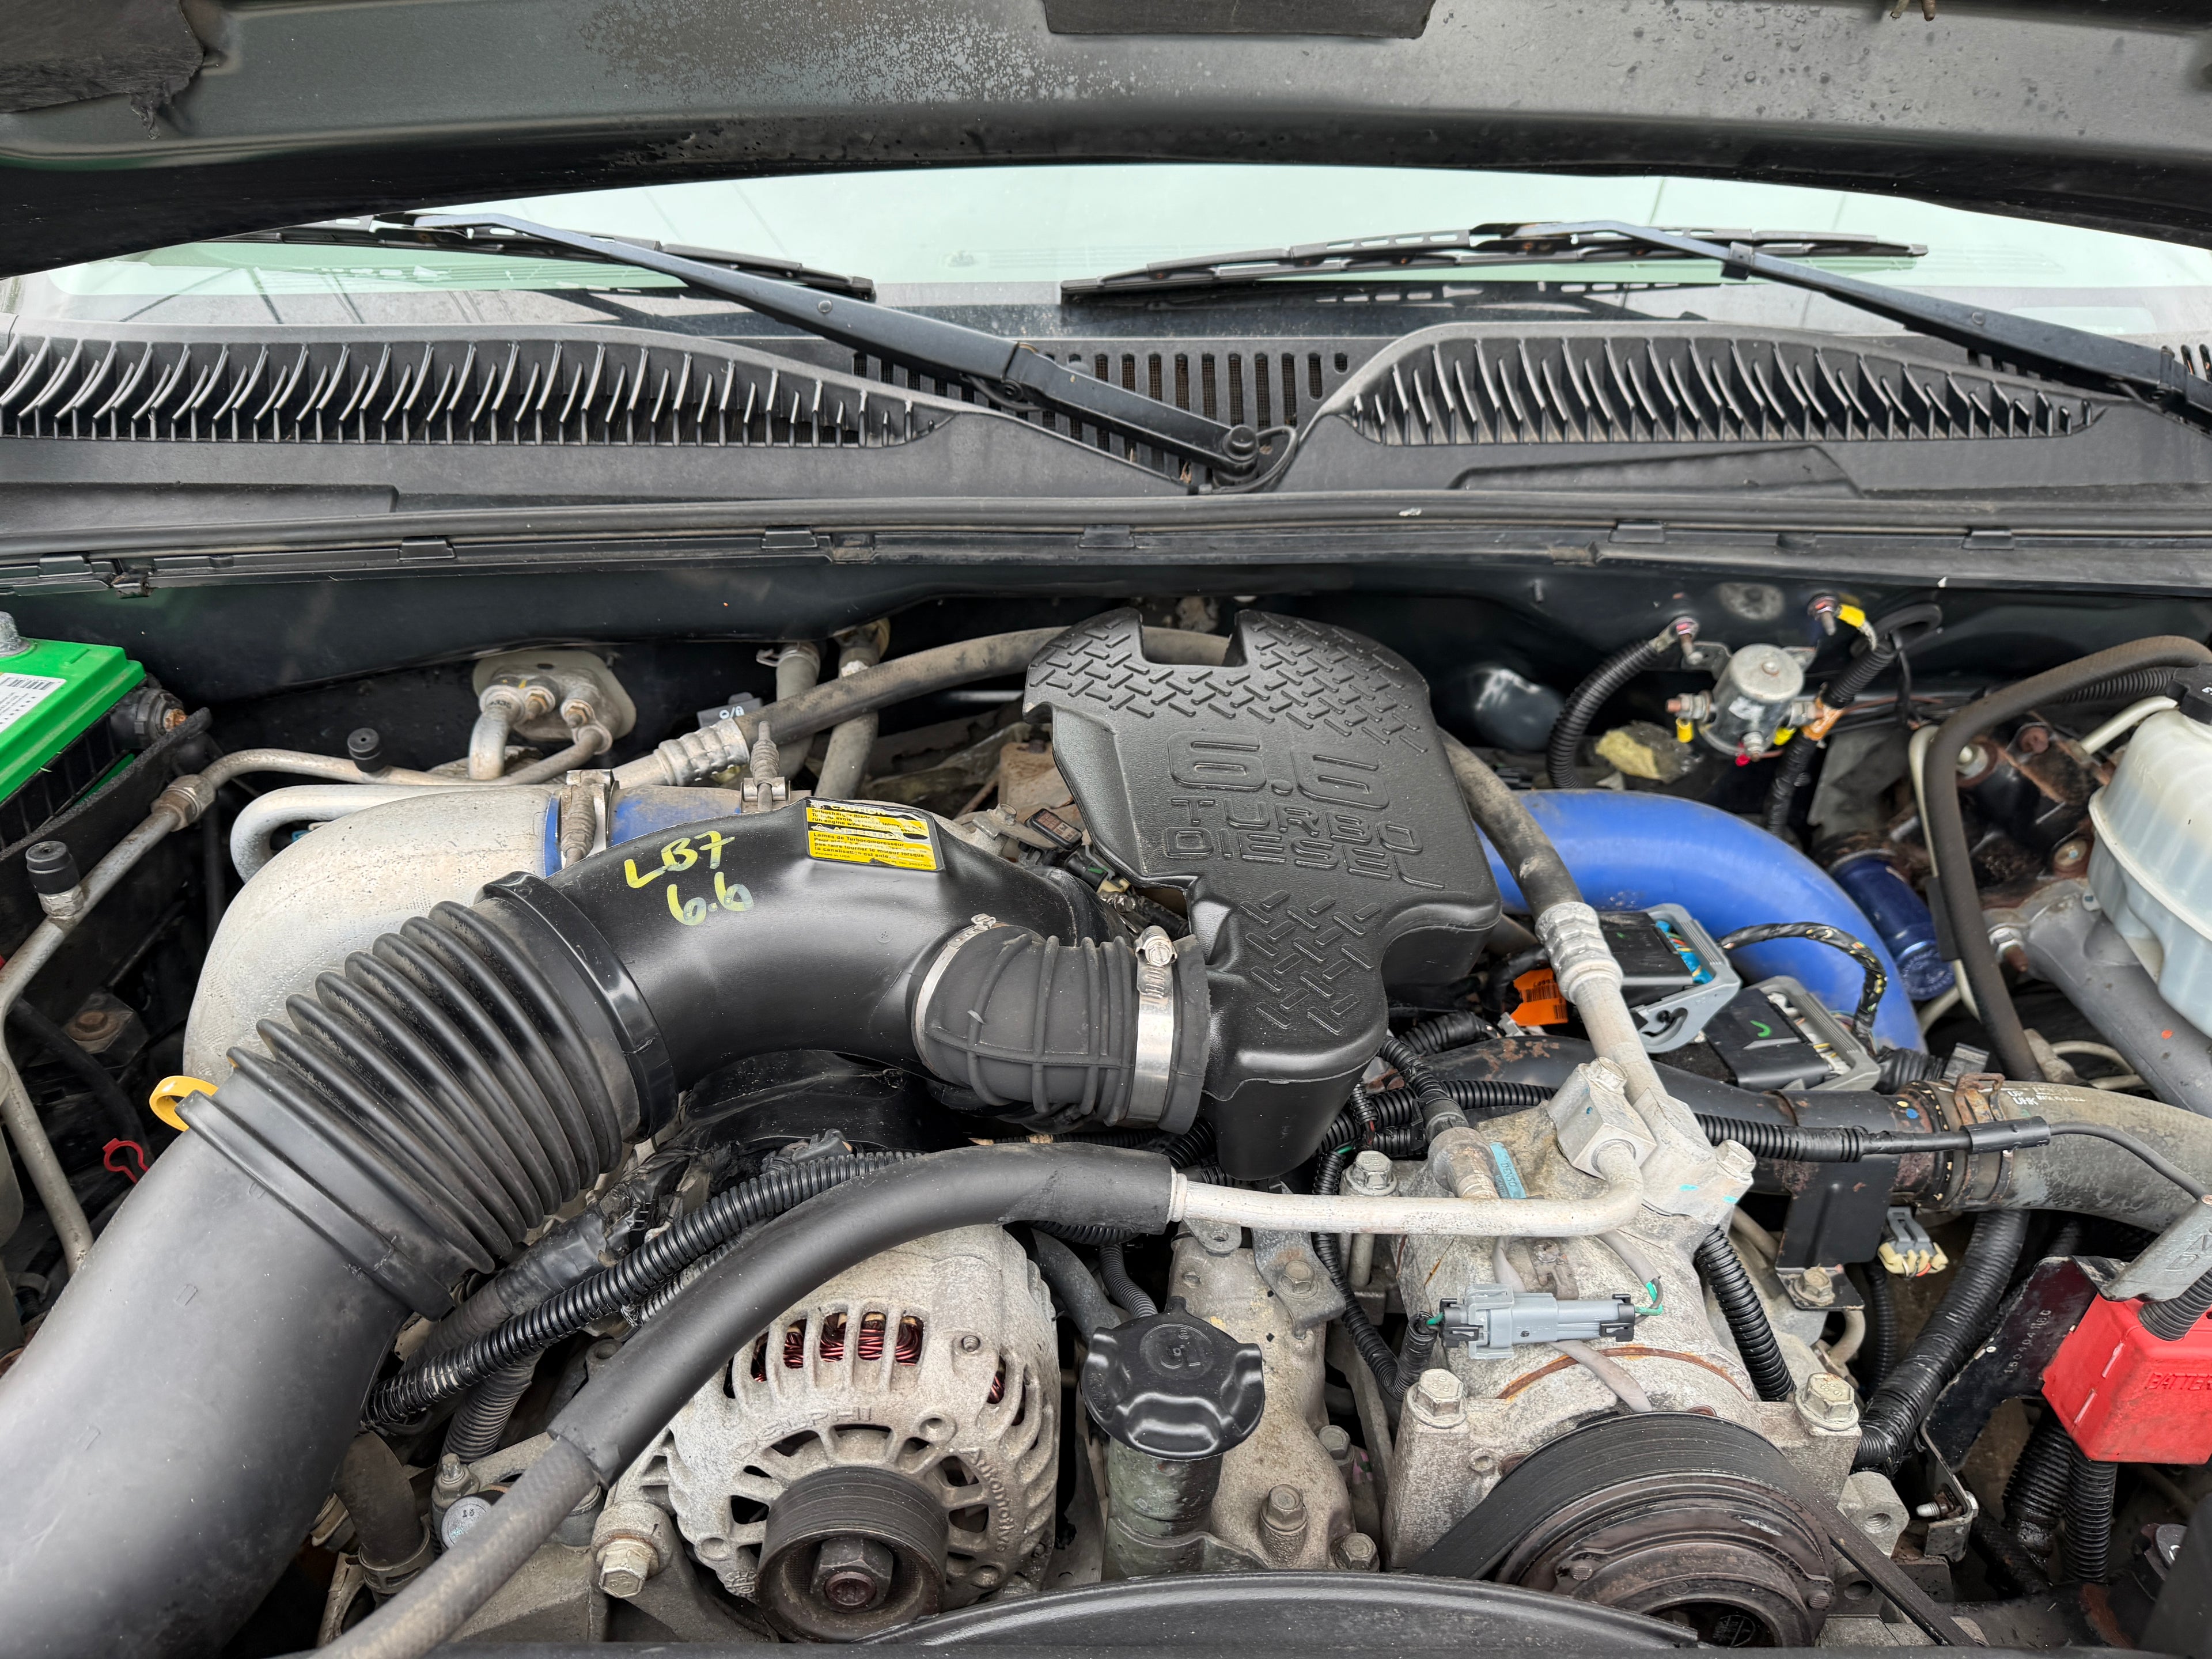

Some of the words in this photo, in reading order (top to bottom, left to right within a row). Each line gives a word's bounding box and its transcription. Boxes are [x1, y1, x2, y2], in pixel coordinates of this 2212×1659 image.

[1168, 731, 1389, 809] 6.6
[830, 804, 886, 815] CAUTION
[1171, 796, 1423, 855] TURBO
[624, 830, 735, 888] LB7
[847, 836, 904, 847] Turbocompresseur
[1165, 827, 1445, 888] DIESEL
[667, 872, 754, 926] 6.6
[1500, 1162, 1517, 1187] DENSO
[734, 1406, 872, 1461] DELPHI
[958, 1448, 1015, 1552] Automotive
